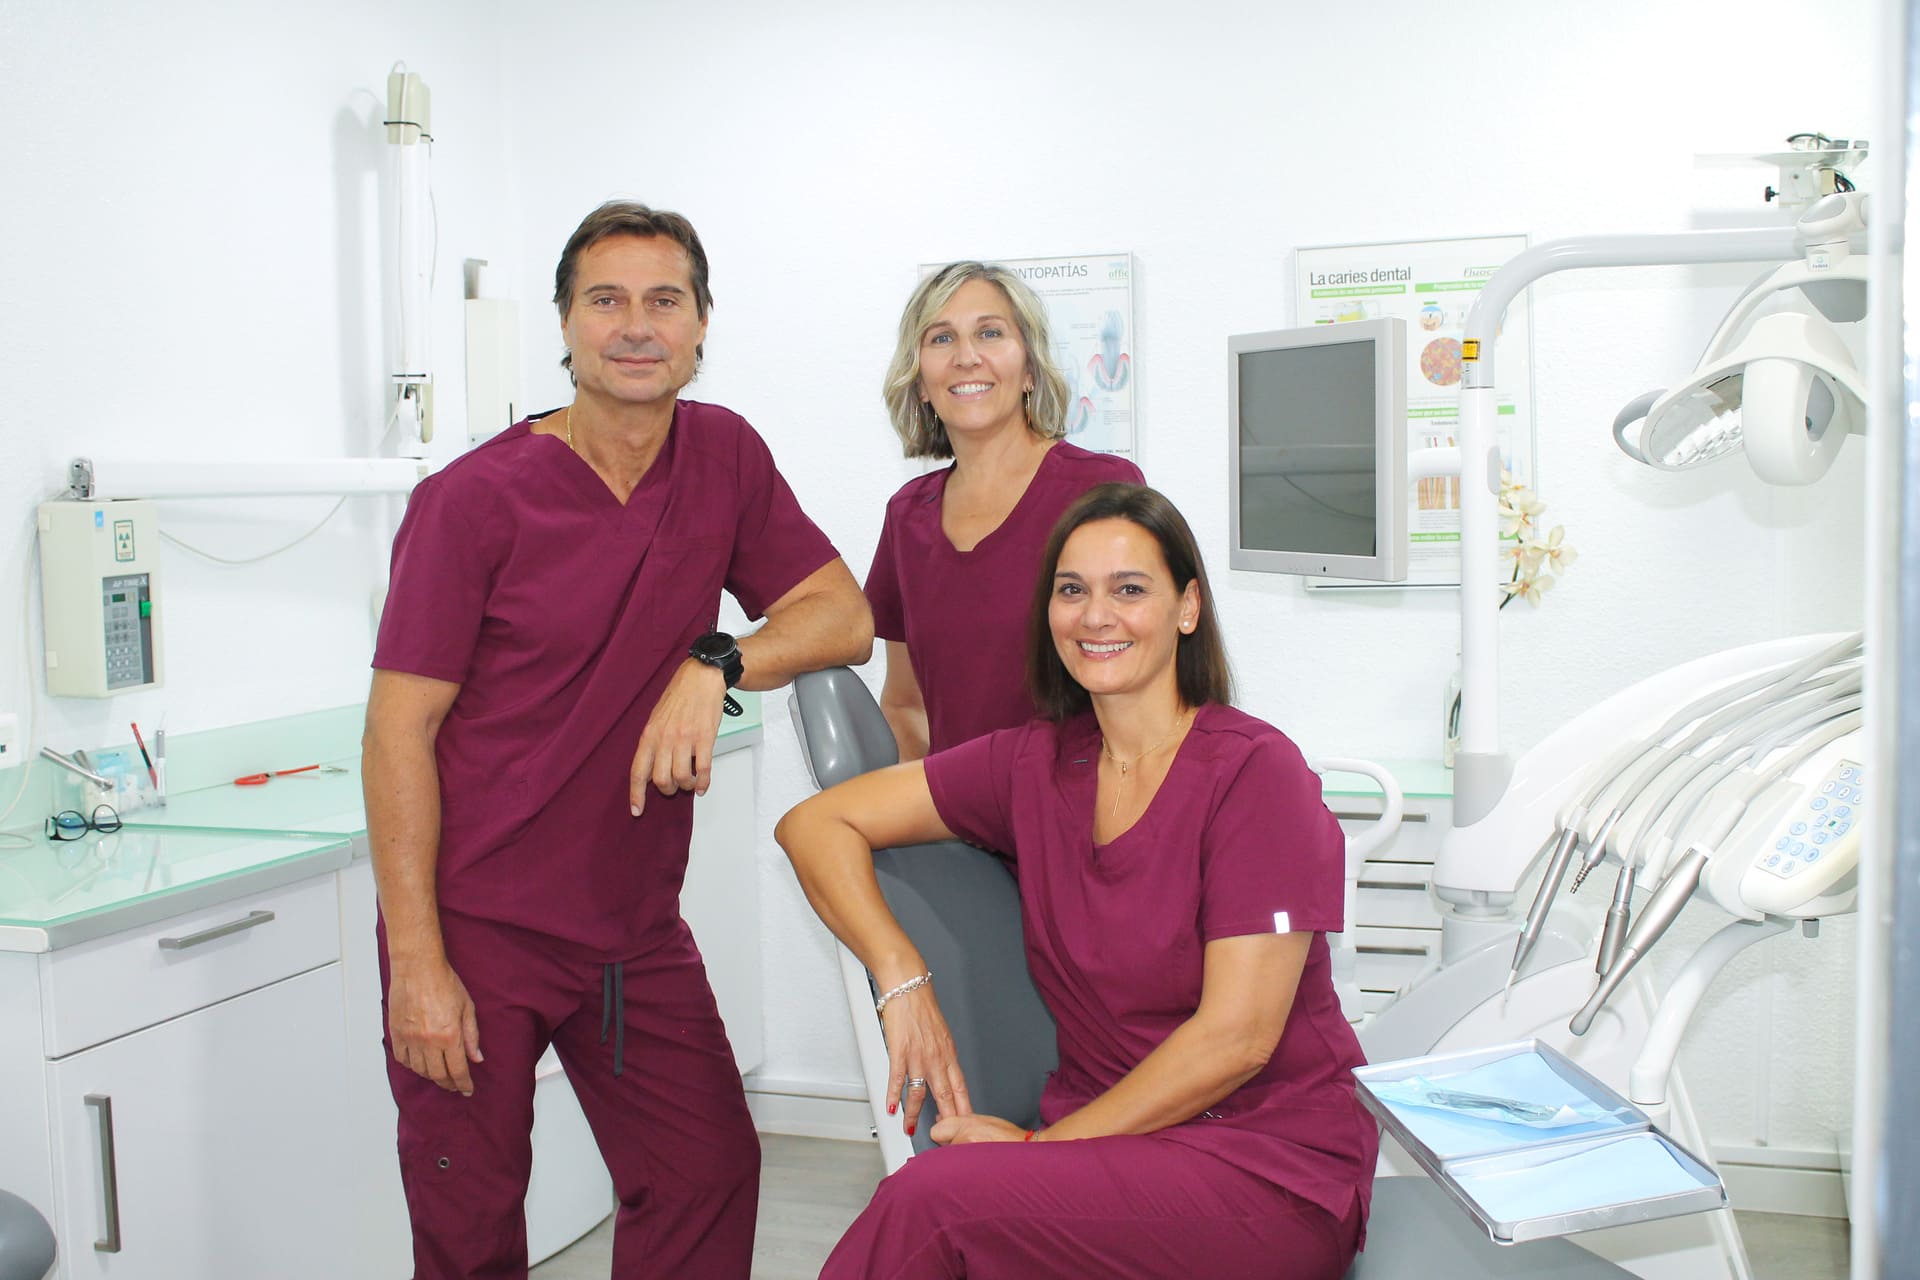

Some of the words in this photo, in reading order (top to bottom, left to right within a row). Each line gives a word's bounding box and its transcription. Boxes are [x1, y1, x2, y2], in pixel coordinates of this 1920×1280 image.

[1310, 271, 1326, 286] La
[1328, 269, 1368, 285] caries
[1370, 266, 1411, 282] dental
